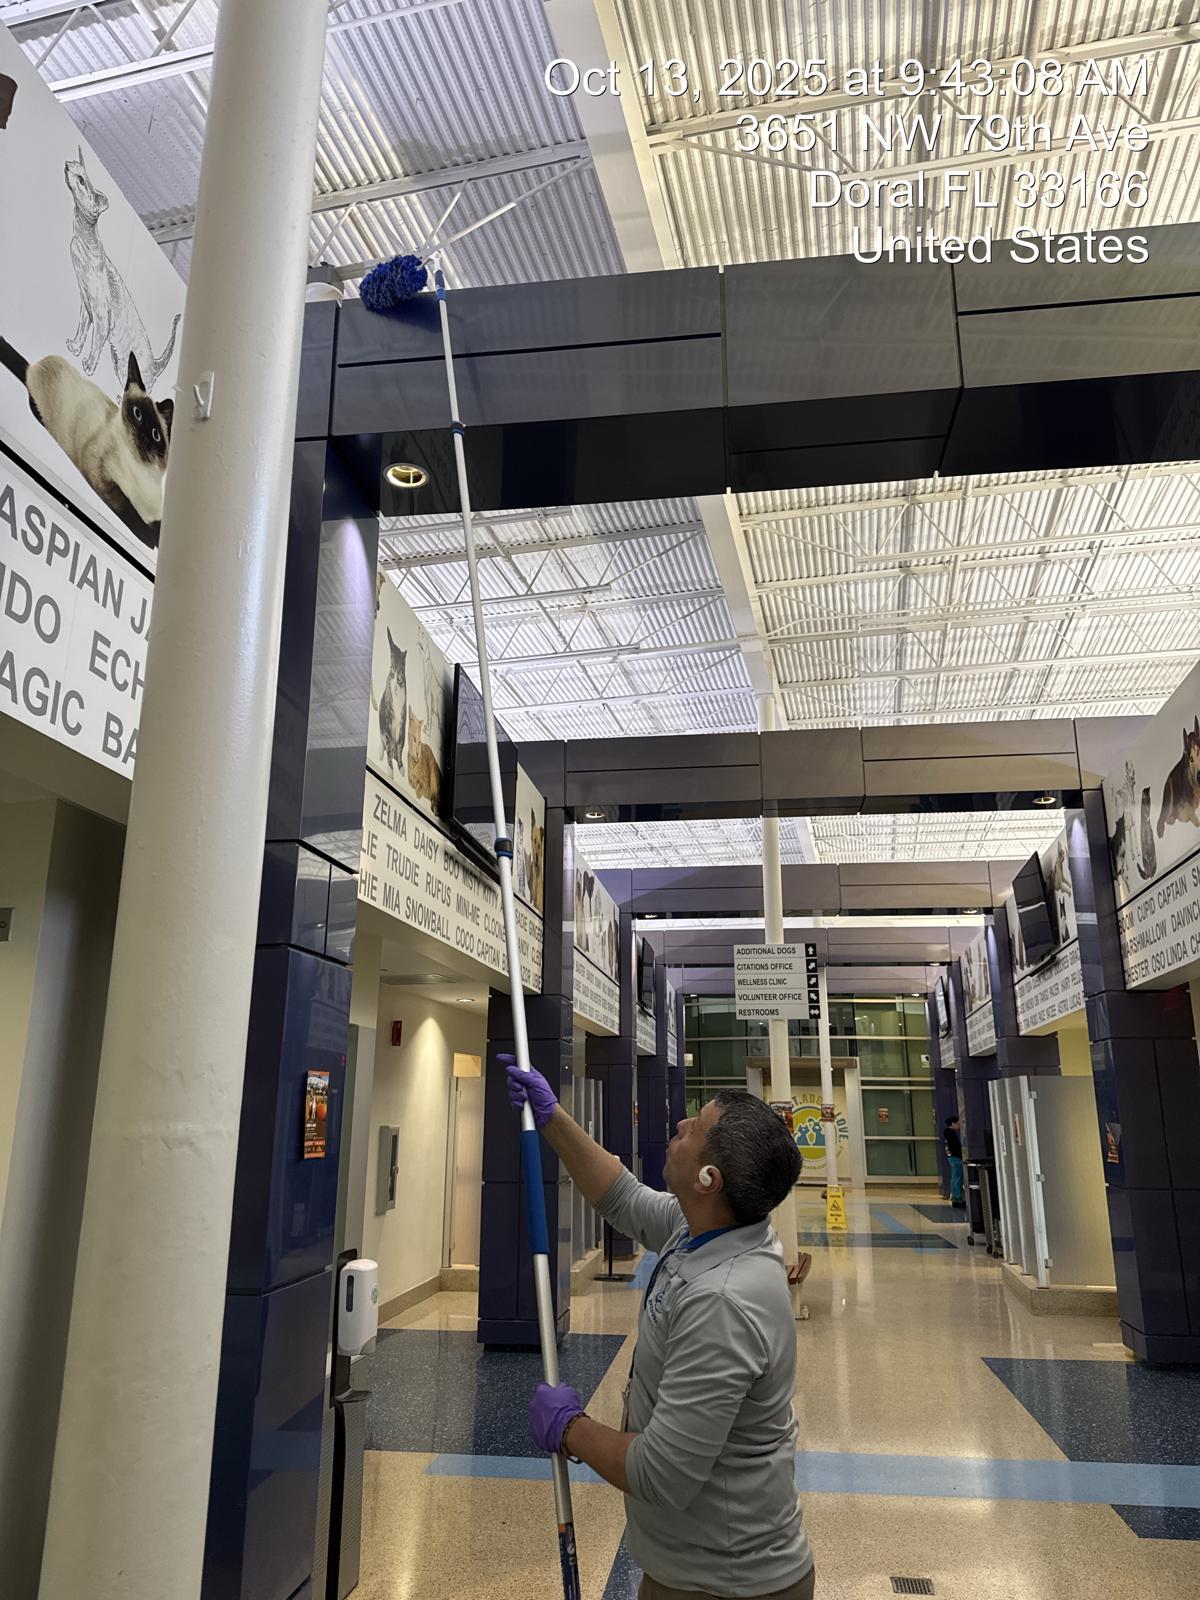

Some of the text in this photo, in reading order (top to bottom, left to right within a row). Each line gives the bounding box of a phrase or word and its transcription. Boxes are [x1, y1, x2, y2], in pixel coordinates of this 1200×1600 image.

[130, 597, 151, 642] J
[373, 793, 407, 843] ZELMA
[413, 825, 439, 864] DAISY
[443, 850, 460, 880] BOO
[386, 843, 420, 888] TRUDIE
[425, 871, 451, 908] RUFUS
[1137, 896, 1156, 923] CUPID
[1157, 874, 1188, 910] CAPTAIN
[382, 882, 401, 915] MIA
[405, 894, 451, 942] SNOWBALL
[455, 925, 475, 953] COCO
[476, 938, 501, 970] CAPITAN
[736, 963, 768, 971] CITATIONS
[1151, 951, 1166, 974] OSO
[1166, 940, 1189, 967] LINDA
[737, 978, 768, 986] WELLNESS
[738, 993, 778, 1001] VOLUNTEER
[738, 1008, 779, 1016] RESTROOMS
